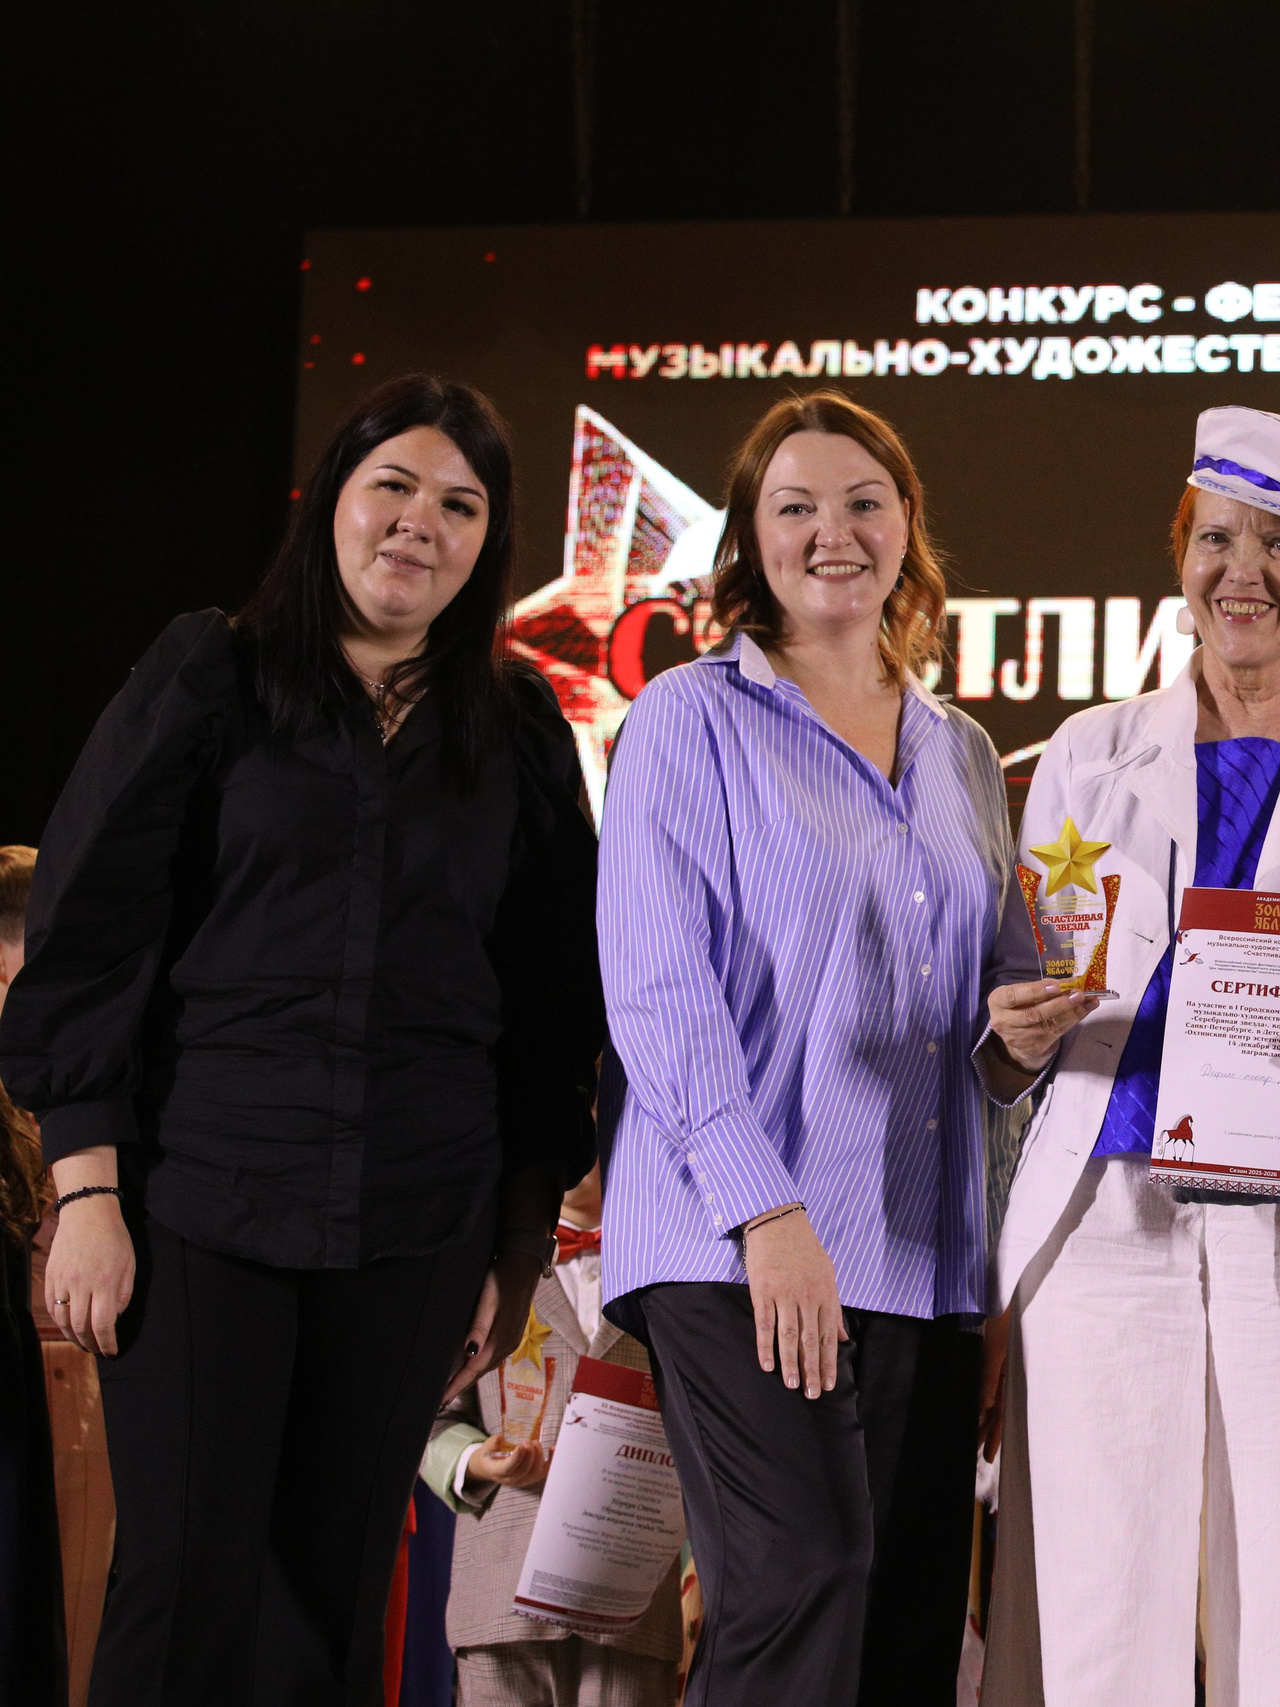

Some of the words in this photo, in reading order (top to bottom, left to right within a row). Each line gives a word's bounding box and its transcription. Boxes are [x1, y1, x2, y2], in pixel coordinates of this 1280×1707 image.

[916, 285, 1163, 324] КОНКУРС
[1041, 913, 1104, 925] СЧАСТЛИВАЯ
[1055, 922, 1091, 932] ЗВЕЗДА
[1218, 934, 1272, 944] Всероссийский
[1197, 1002, 1227, 1010] участие
[1239, 1005, 1280, 1015] Городском
[1191, 1015, 1238, 1025] «Серебряная
[1238, 1042, 1270, 1050] декабря
[1229, 1167, 1248, 1175] Сезон
[1248, 1168, 1278, 1177] 2025-2026
[615, 1444, 676, 1469] ДИПЛО
